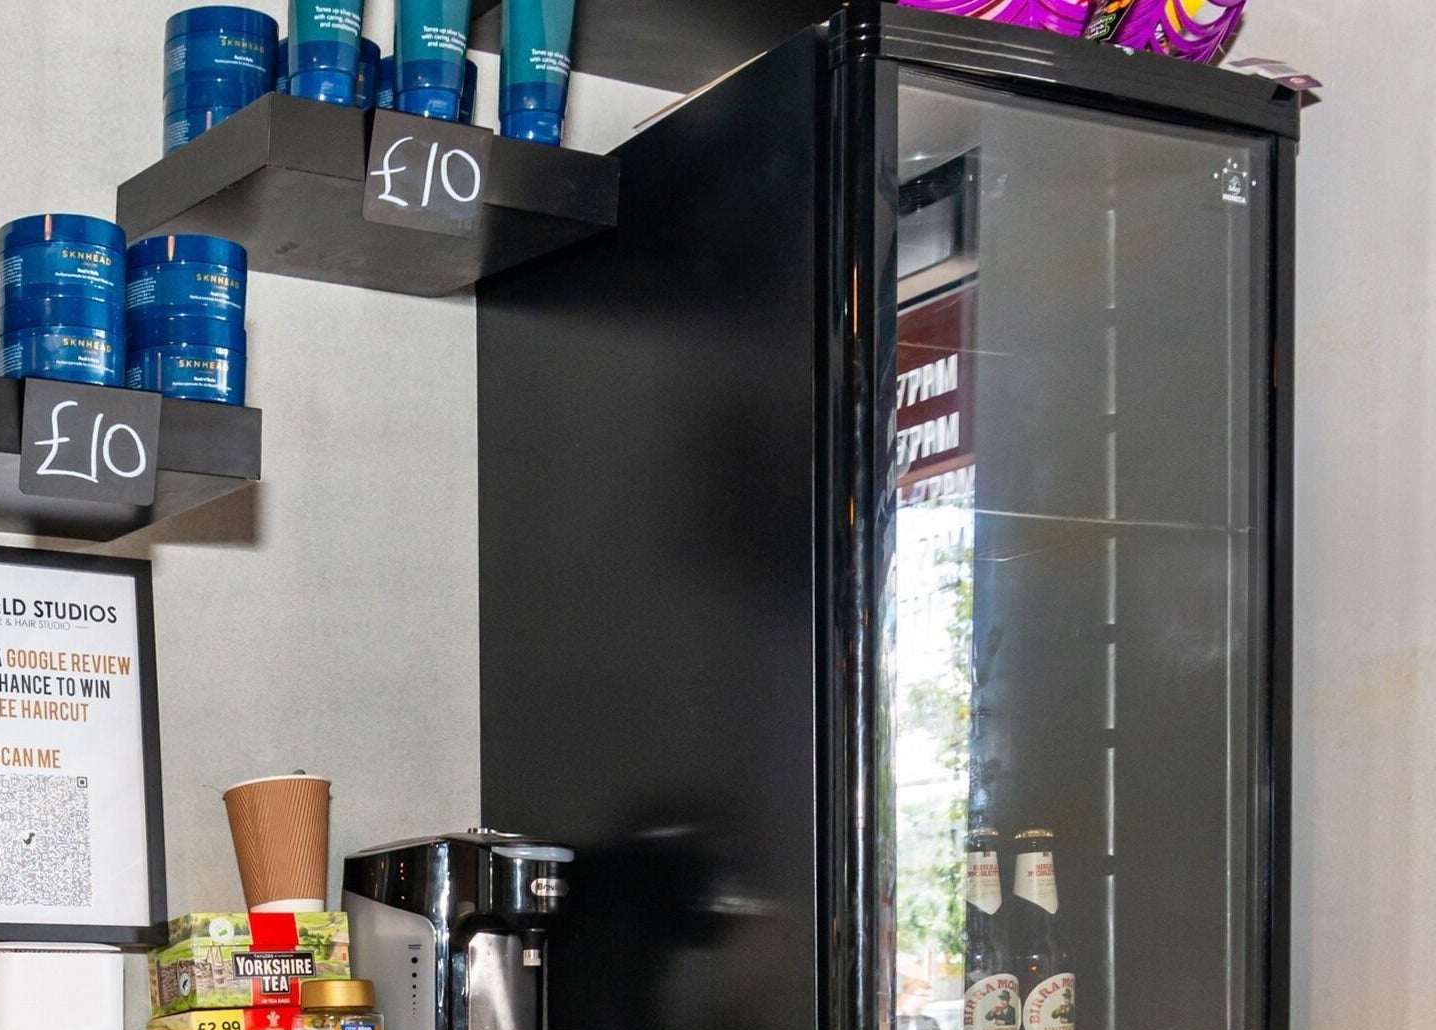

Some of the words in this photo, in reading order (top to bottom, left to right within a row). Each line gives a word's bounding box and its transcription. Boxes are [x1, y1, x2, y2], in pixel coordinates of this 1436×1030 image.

[370, 136, 481, 207] £10
[61, 250, 112, 266] SKNHEAD
[196, 273, 240, 289] SKNHEAD
[62, 338, 112, 353] SKNHEAD
[178, 359, 230, 373] SKNHEAD
[34, 400, 146, 484] £10
[34, 600, 118, 624] STUDIOS
[5, 617, 13, 626] &
[15, 619, 37, 628] HAIR
[38, 621, 71, 631] STUDIO
[7, 648, 67, 672] GOOGLE
[71, 652, 131, 675] REVIEW
[56, 677, 76, 696] TO
[80, 678, 111, 699] WIN
[21, 700, 89, 722] HAIRCUT
[37, 748, 61, 769] ME
[236, 956, 312, 975] YORKSHIRE
[263, 976, 289, 992] TEA
[964, 983, 995, 1026] BIRRA
[1029, 981, 1060, 1025] BIRRA
